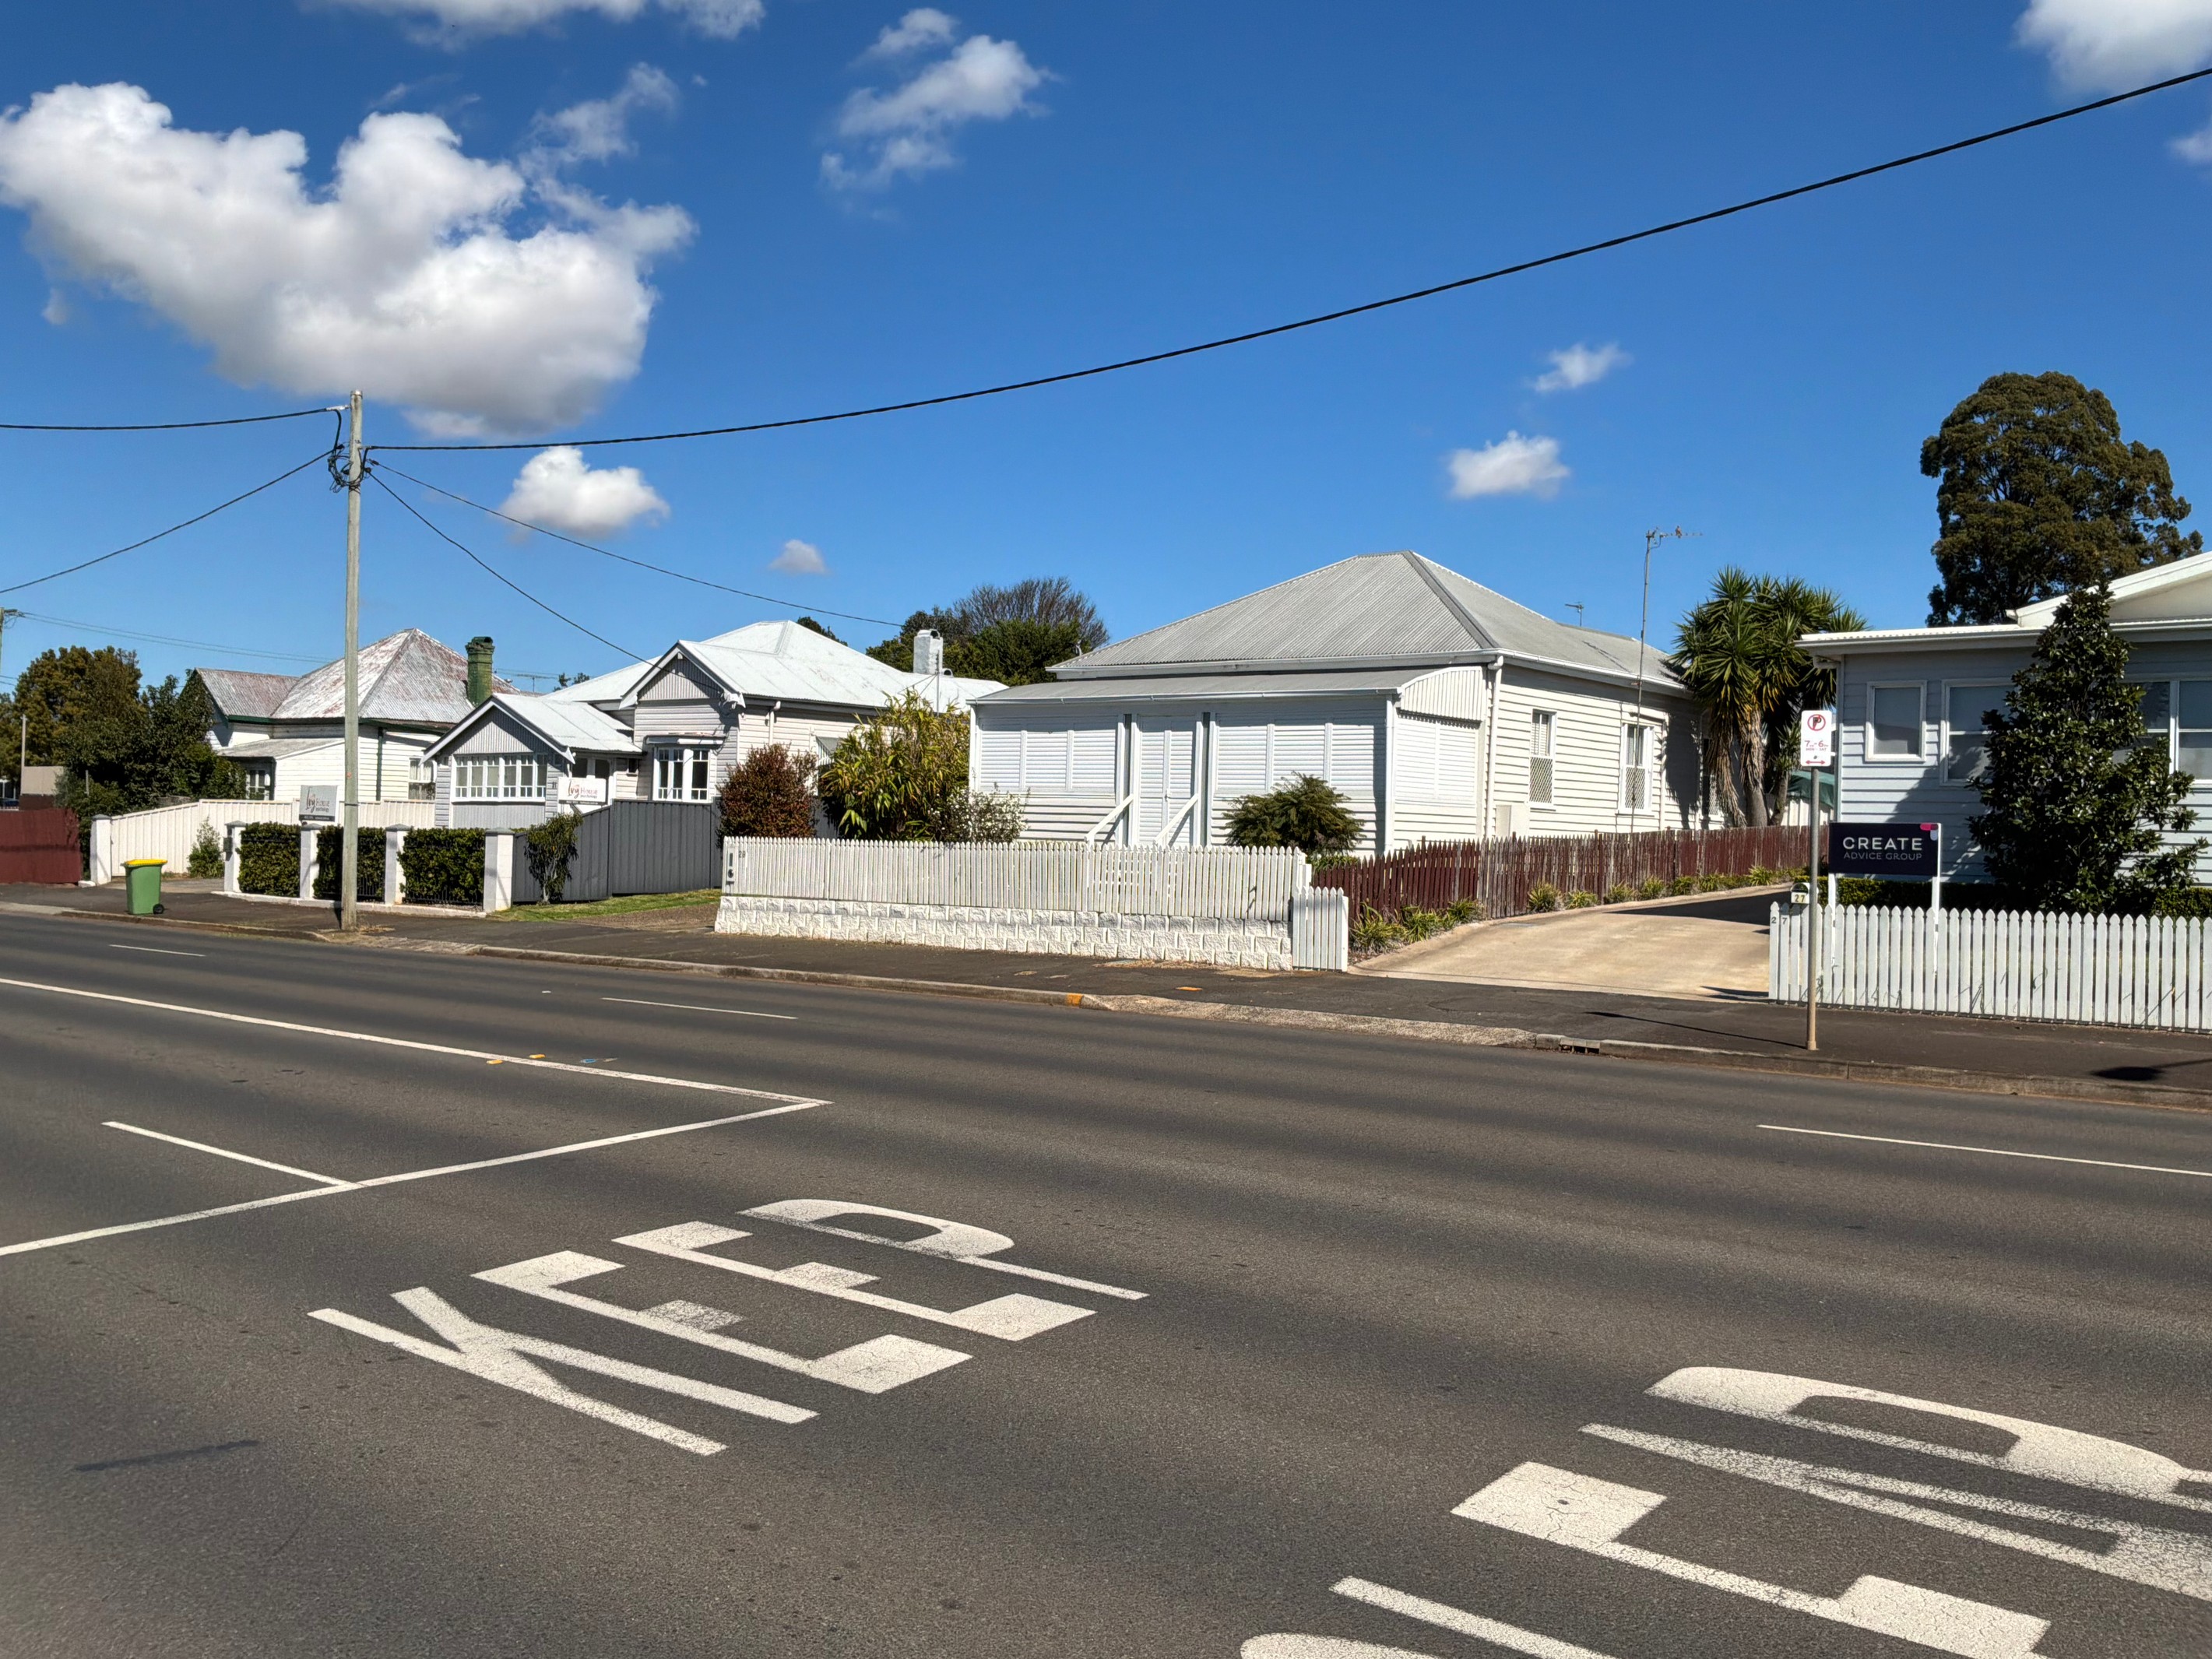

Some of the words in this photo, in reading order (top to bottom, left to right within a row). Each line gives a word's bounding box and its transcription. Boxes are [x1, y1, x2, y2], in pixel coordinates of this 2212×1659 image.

[1842, 837, 1922, 850] CREATE
[1795, 894, 1806, 903] 27
[1771, 916, 1788, 925] 27
[308, 1198, 1149, 1456] KEEP
[1240, 1366, 2212, 1659] EAR
